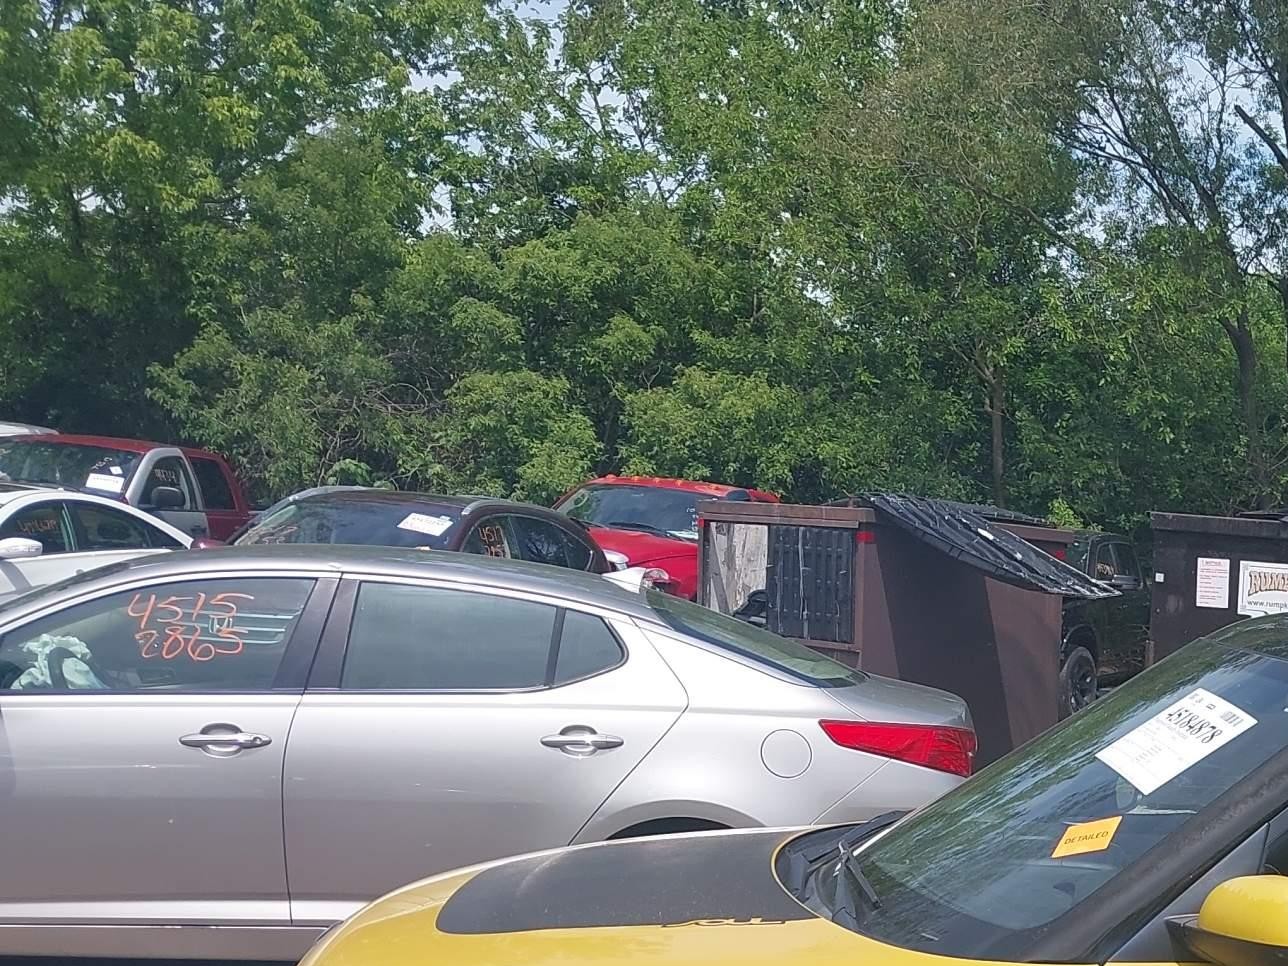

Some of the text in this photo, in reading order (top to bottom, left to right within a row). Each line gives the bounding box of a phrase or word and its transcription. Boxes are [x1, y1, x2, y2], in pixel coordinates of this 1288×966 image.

[127, 592, 255, 629] 4515
[134, 622, 249, 661] 2865
[1166, 706, 1223, 744] 45184878
[1064, 831, 1109, 845] DETAILED
